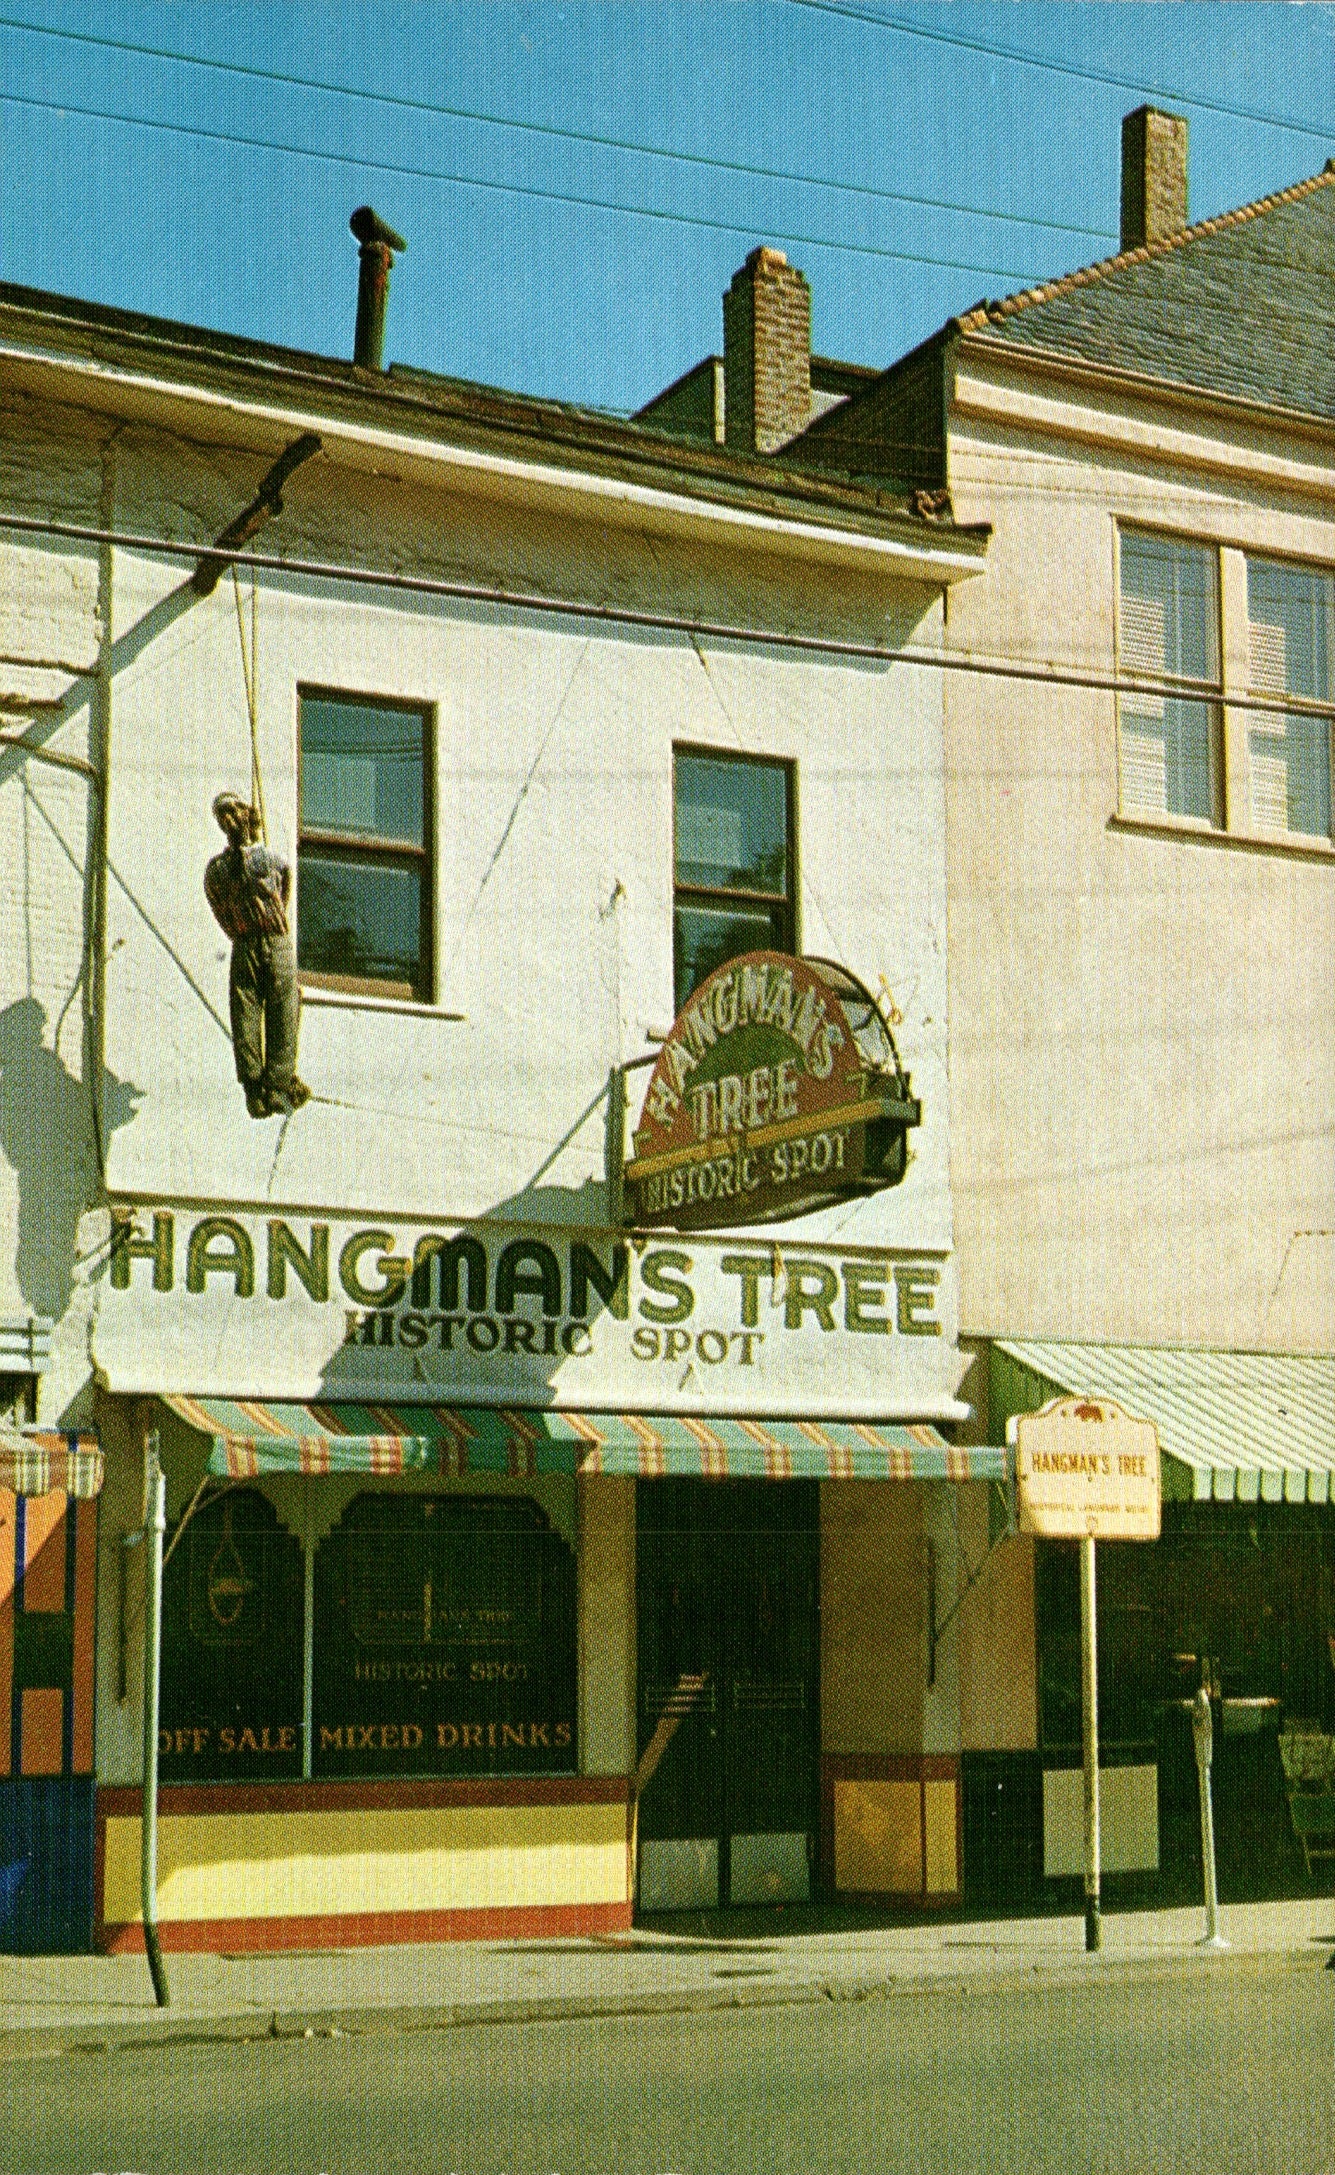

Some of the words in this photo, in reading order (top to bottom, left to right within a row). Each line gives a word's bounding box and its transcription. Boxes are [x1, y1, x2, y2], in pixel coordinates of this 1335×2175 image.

[648, 963, 846, 1131] HANGMAN'S
[691, 1057, 798, 1141] TREE
[643, 1152, 761, 1212] HISTORIC
[771, 1130, 848, 1184] SPOT
[720, 1253, 942, 1337] TREE
[344, 1309, 593, 1357] HISTORIC
[630, 1327, 766, 1366] SPOT
[1032, 1453, 1111, 1474] HANGMAN'S
[1118, 1455, 1147, 1477] TREE
[354, 1660, 455, 1681] HISTORIC
[470, 1660, 528, 1681] SPOT
[219, 1727, 296, 1753] SALE
[319, 1724, 423, 1750] MIXED
[436, 1722, 571, 1748] DRINKS
